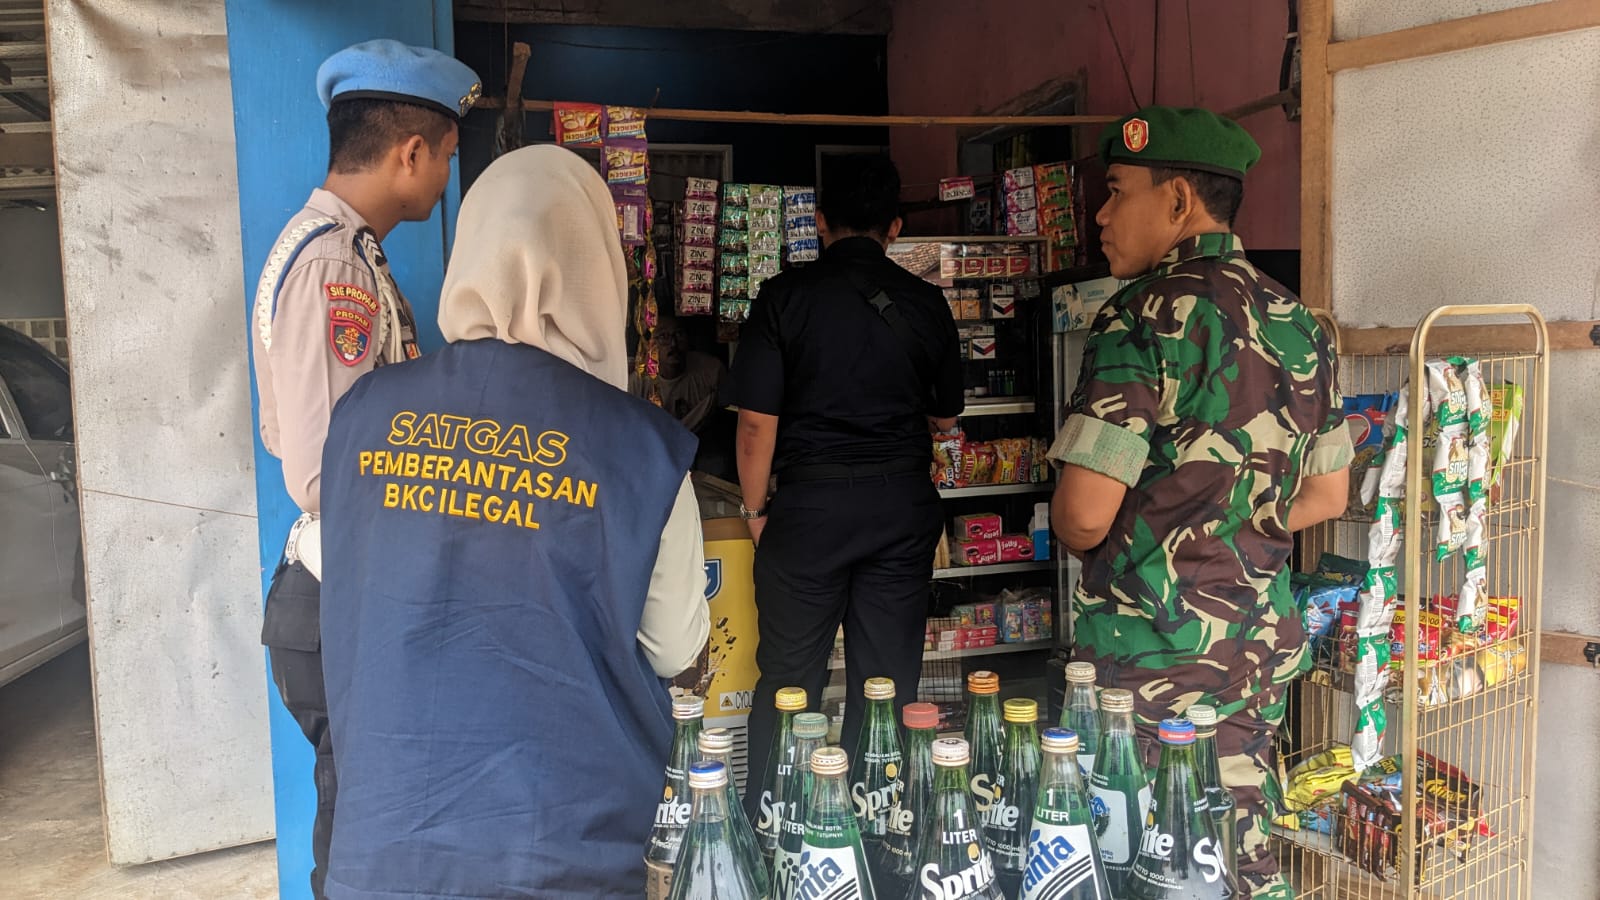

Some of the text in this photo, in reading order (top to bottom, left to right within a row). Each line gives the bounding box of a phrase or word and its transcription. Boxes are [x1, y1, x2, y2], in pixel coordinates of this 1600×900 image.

[694, 180, 712, 189] ZINC
[692, 202, 711, 212] ZINC
[691, 226, 709, 235] ZINC
[690, 249, 708, 258] ZINC
[689, 272, 707, 281] ZINC
[330, 286, 377, 311] SIE PROPAM
[687, 295, 706, 304] ZINC
[335, 310, 369, 327] PROPAM
[387, 411, 570, 467] SATGAS
[359, 451, 598, 508] PEMBERANTASAN
[787, 746, 795, 763] 1
[777, 763, 792, 775] LIT
[1046, 788, 1054, 806] 1
[655, 795, 692, 825] rite
[790, 801, 797, 820] 1
[953, 808, 964, 829] 1
[1036, 807, 1069, 822] LITER
[782, 818, 805, 835] LITER
[942, 828, 977, 845] LITER
[921, 848, 996, 900] Sprite
[1149, 871, 1164, 882] 1000
